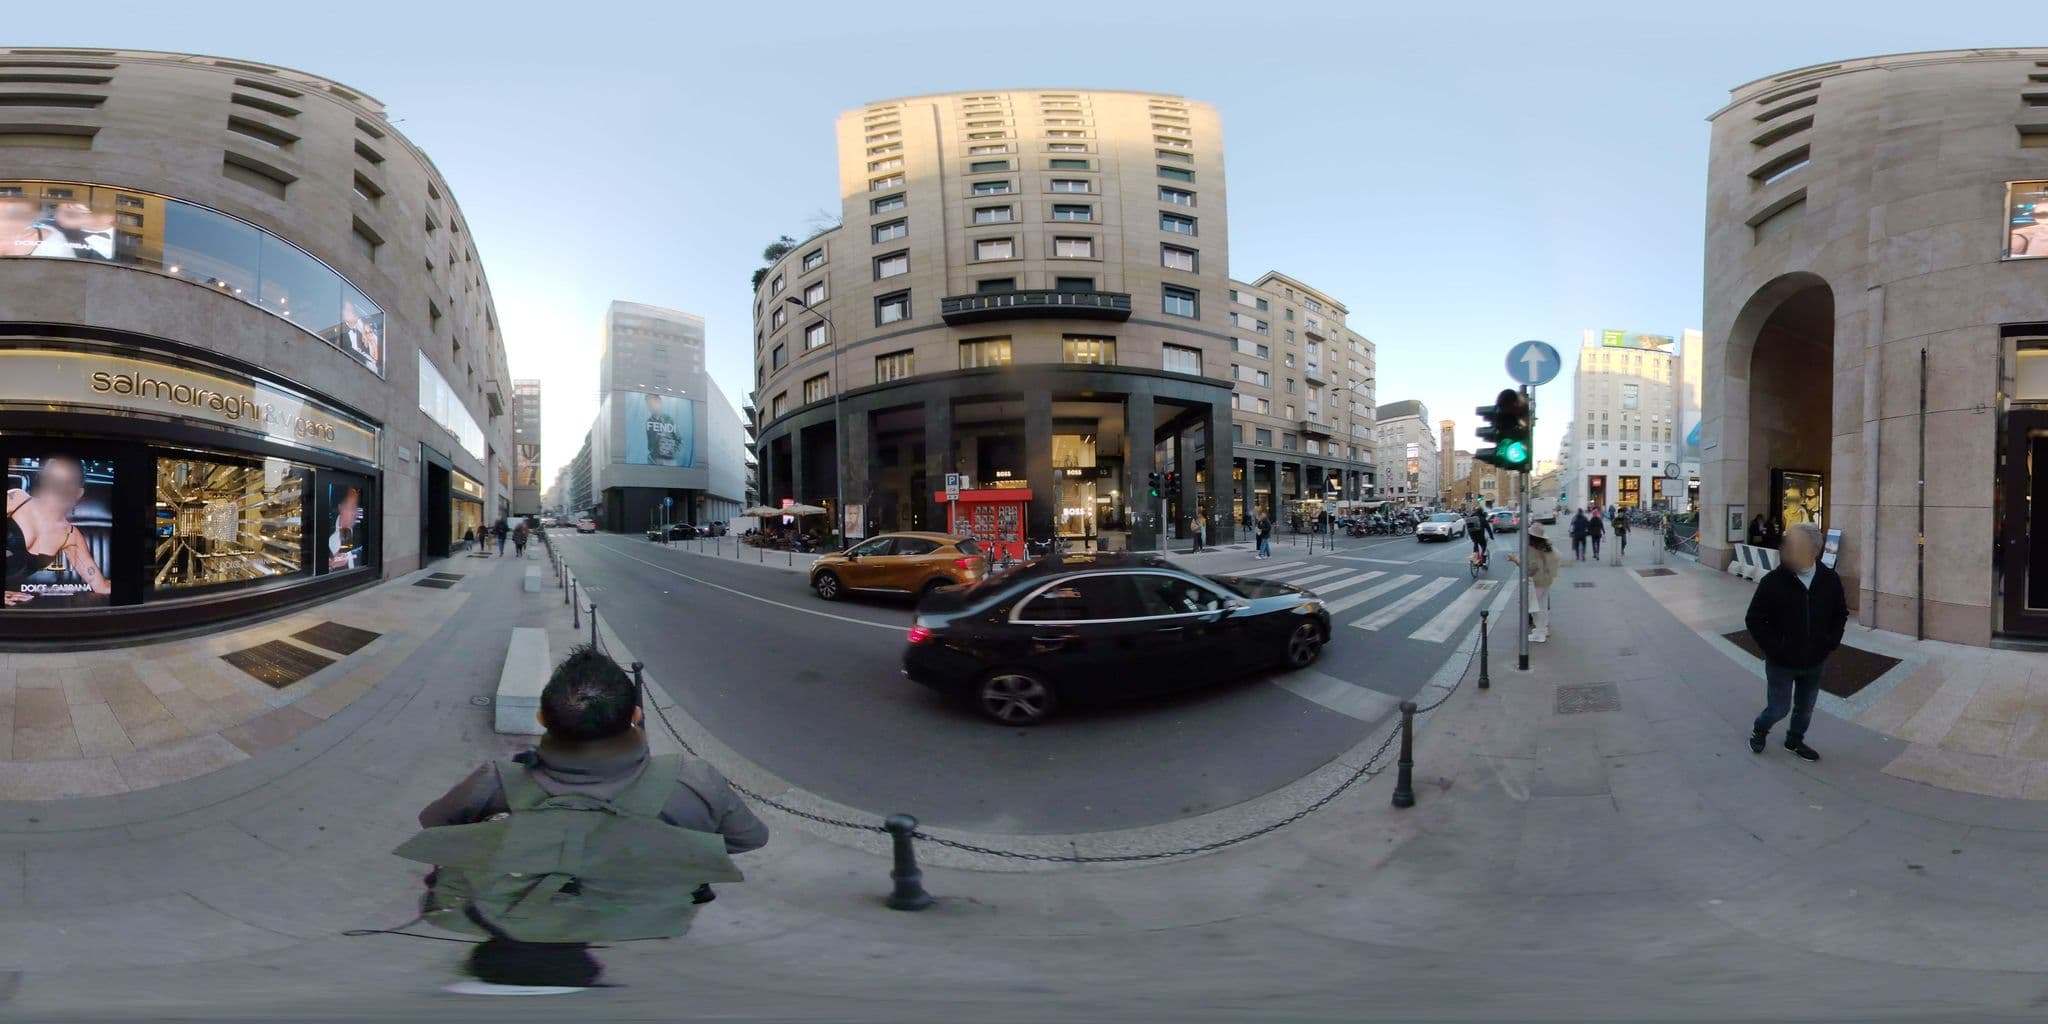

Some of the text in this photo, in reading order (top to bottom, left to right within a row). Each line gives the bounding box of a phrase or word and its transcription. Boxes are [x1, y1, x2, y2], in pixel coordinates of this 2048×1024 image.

[91, 371, 260, 420] salmoiraghi
[647, 421, 677, 433] FENDI
[949, 476, 956, 484] P
